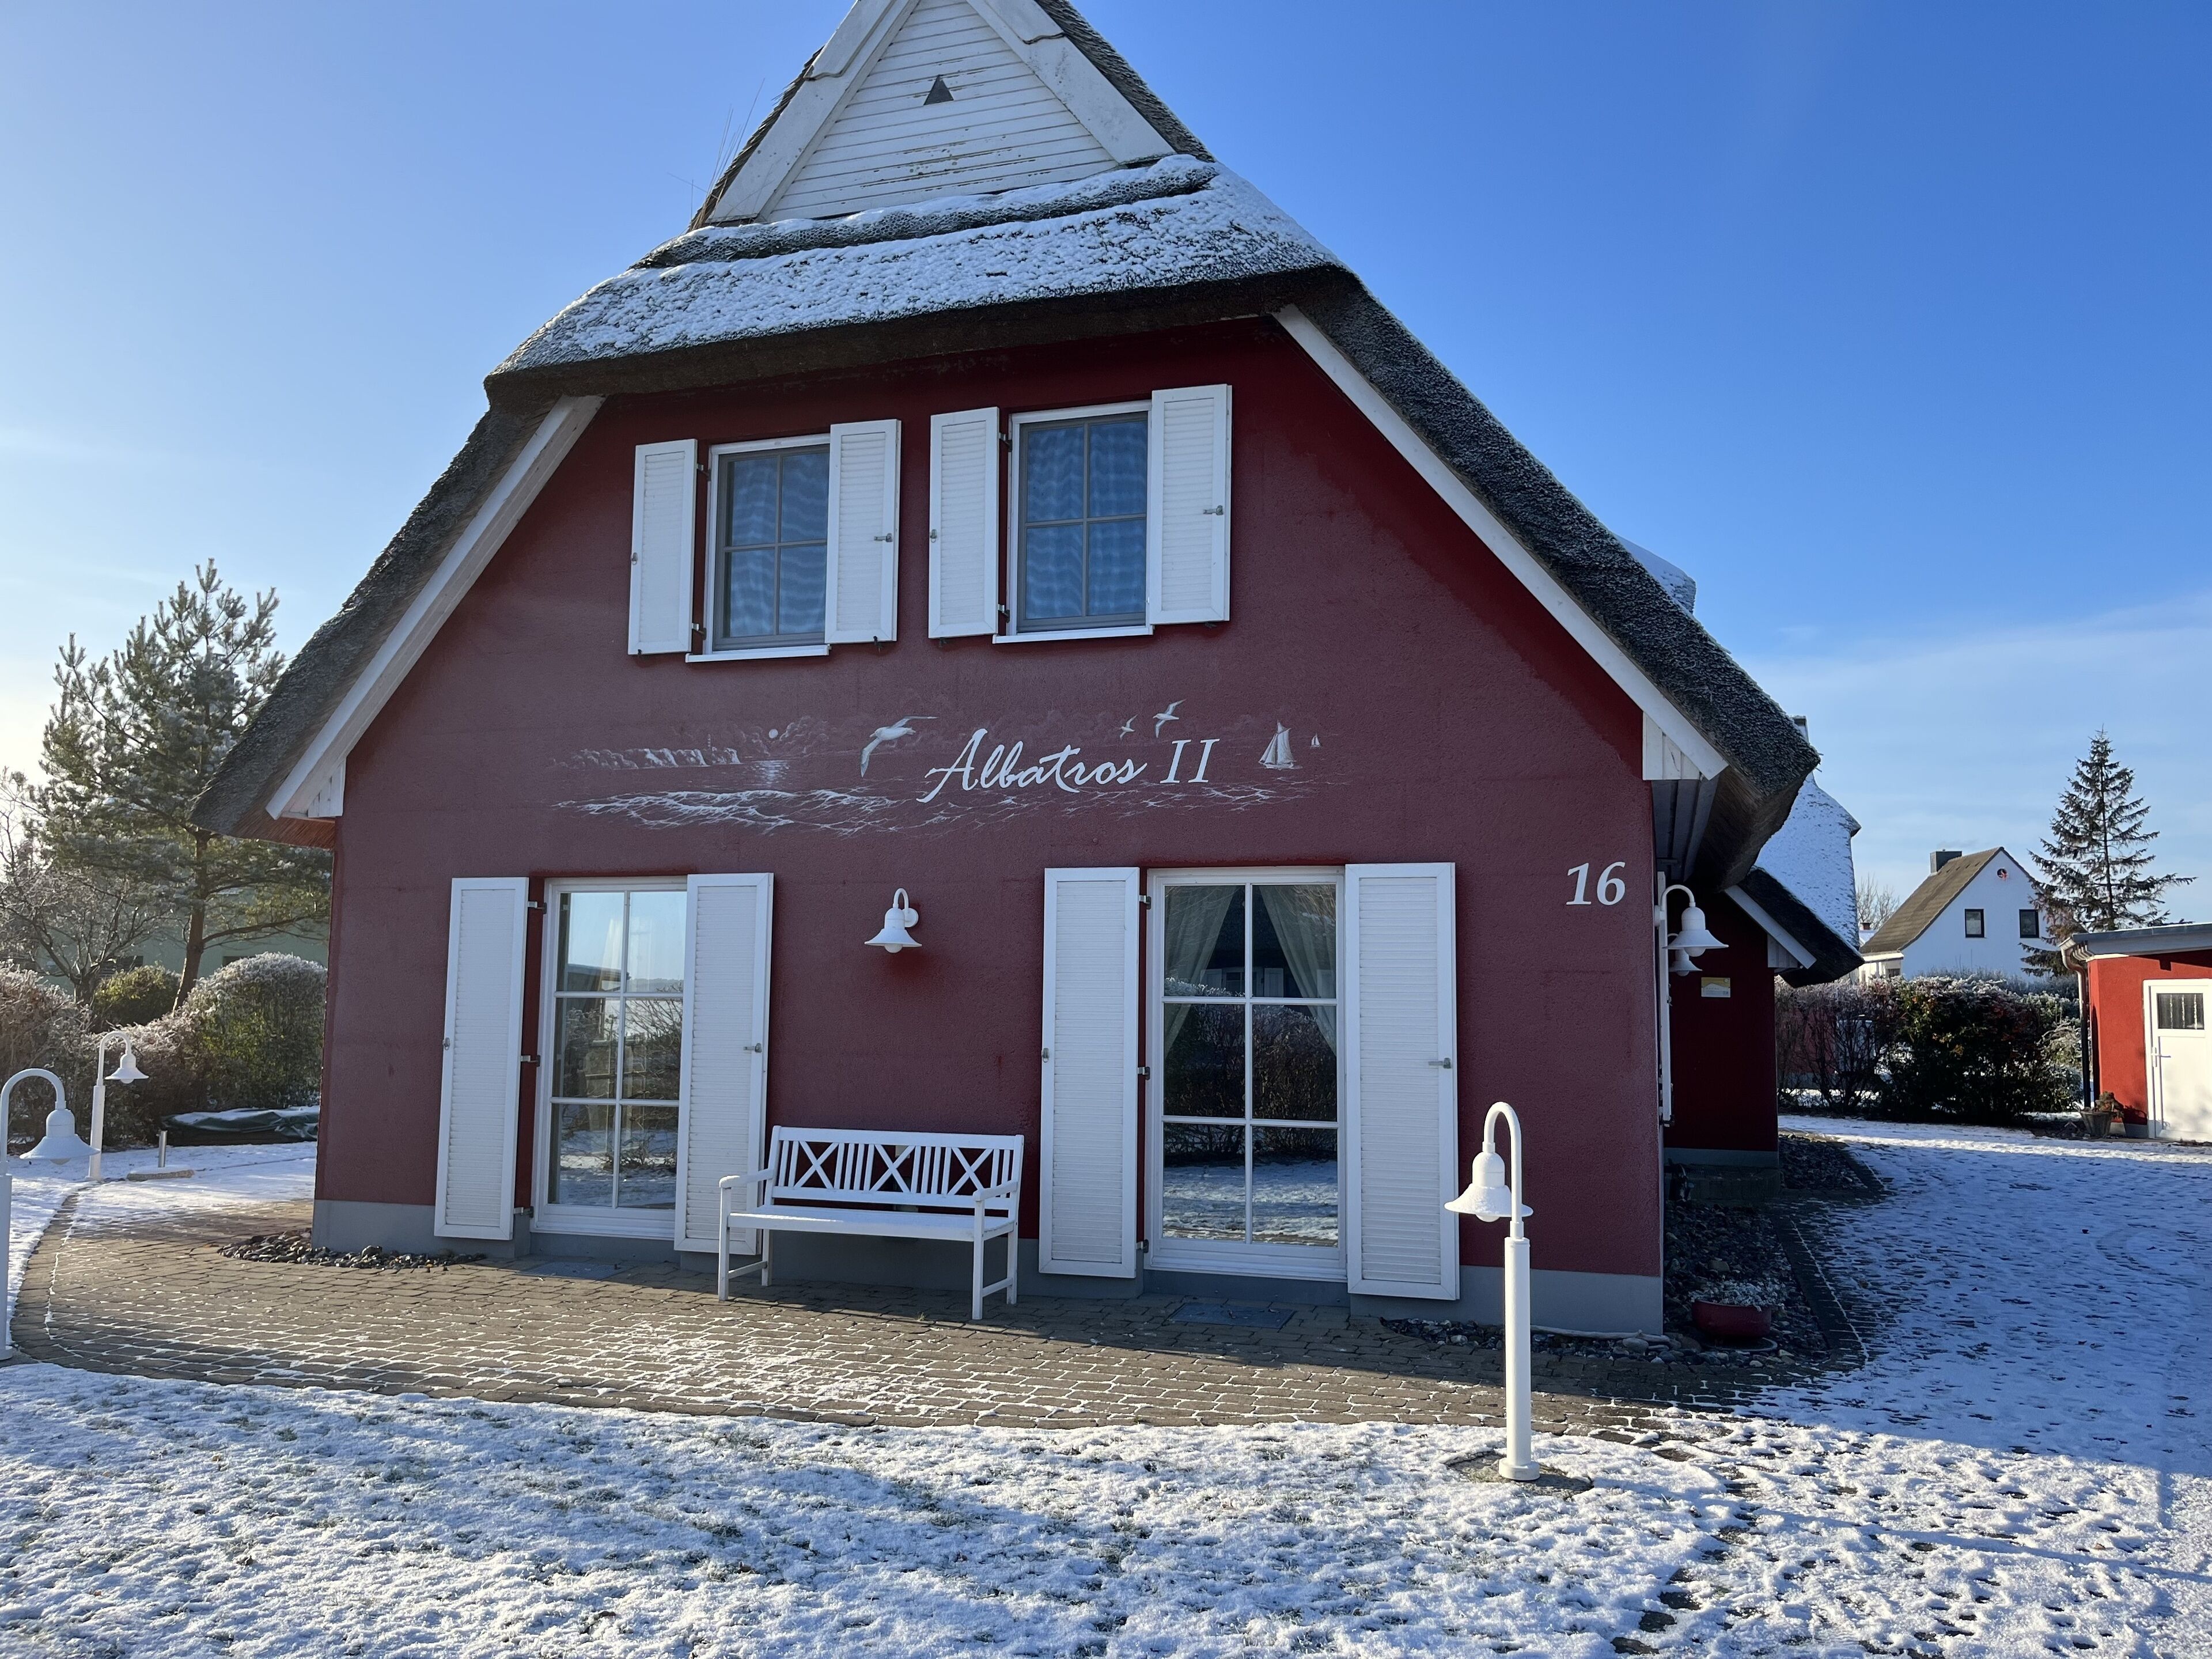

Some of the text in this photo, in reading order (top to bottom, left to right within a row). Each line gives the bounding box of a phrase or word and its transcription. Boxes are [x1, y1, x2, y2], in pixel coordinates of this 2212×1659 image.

[916, 728, 1220, 803] Albatros II
[1566, 861, 1626, 906] 16
